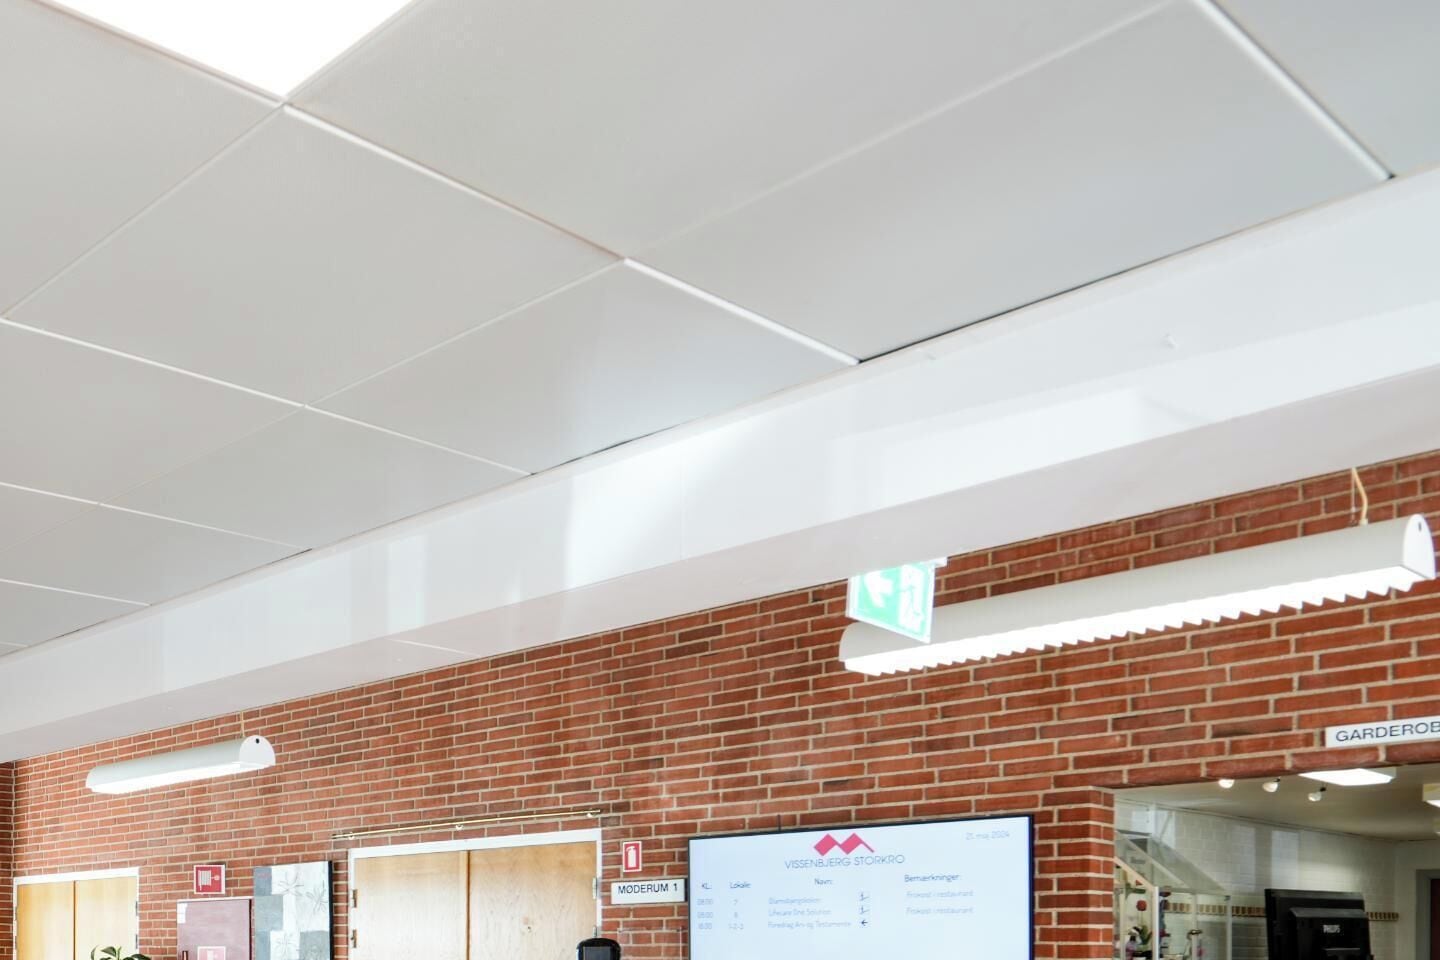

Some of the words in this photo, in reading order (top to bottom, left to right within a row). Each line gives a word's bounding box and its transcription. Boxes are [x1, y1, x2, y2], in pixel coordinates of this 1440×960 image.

[784, 858, 851, 869] VISSENBJERG
[854, 854, 905, 866] STORKRO
[618, 883, 669, 894] MØDERUM
[673, 882, 678, 892] 1
